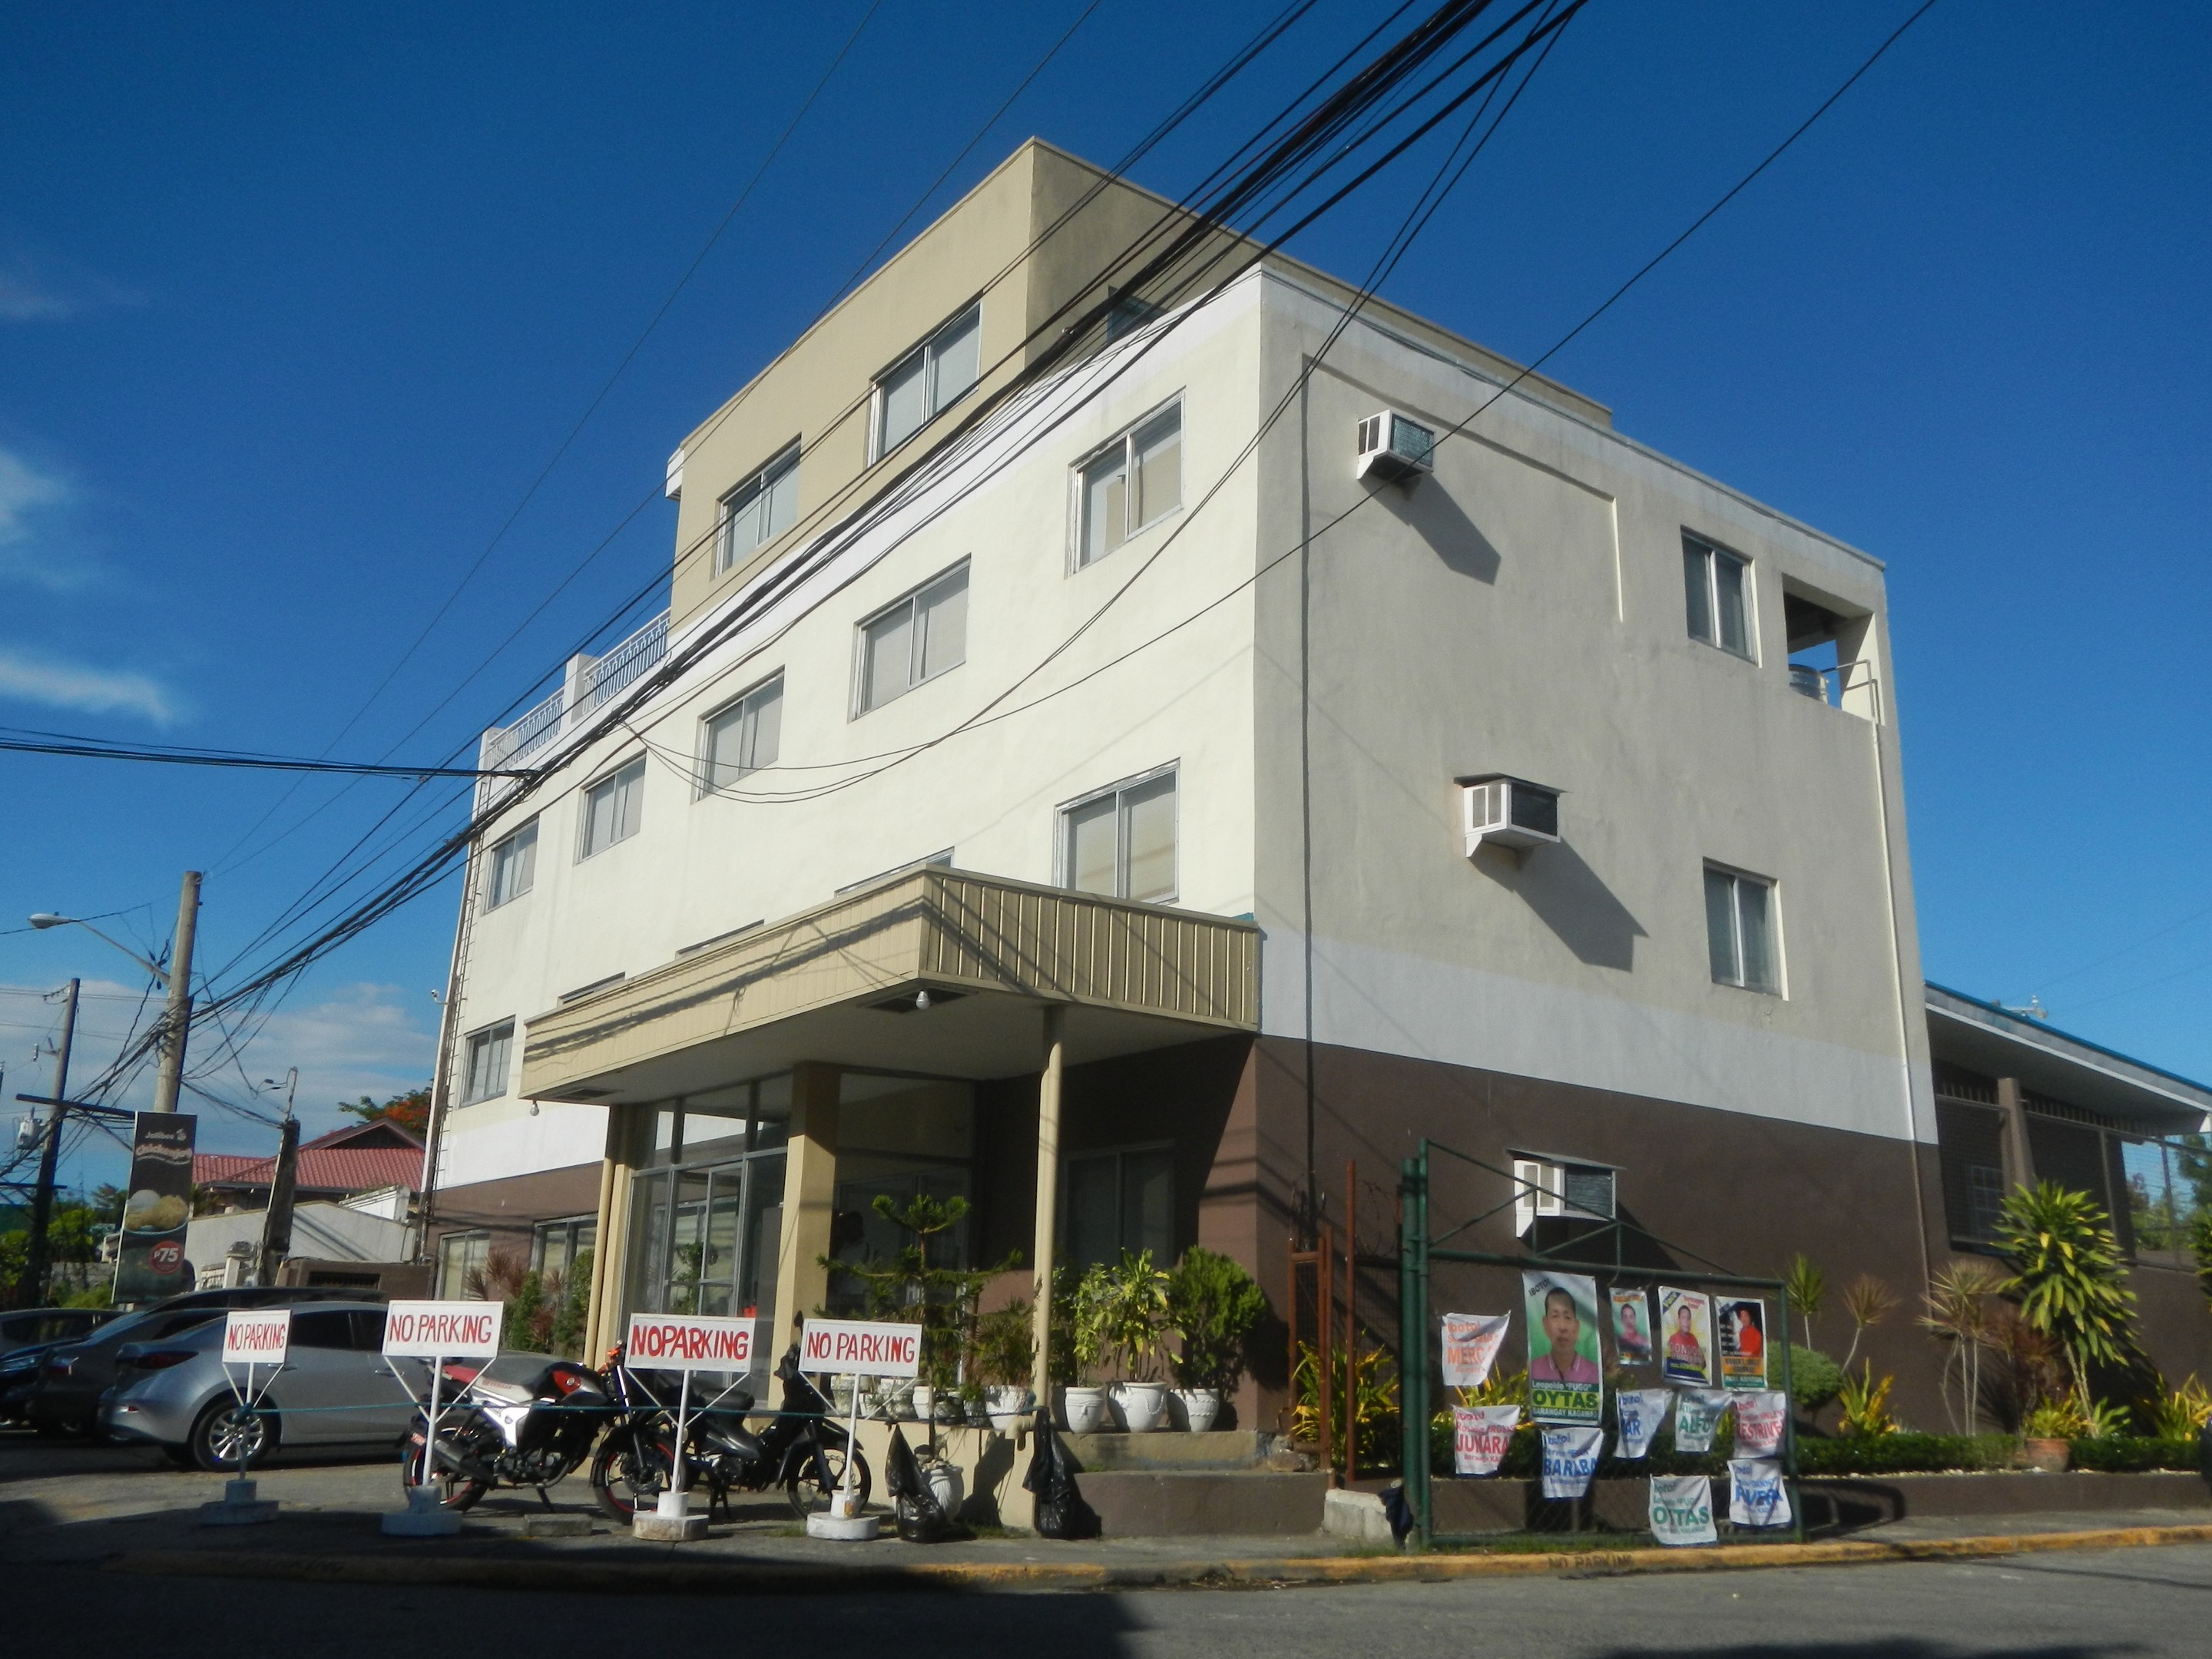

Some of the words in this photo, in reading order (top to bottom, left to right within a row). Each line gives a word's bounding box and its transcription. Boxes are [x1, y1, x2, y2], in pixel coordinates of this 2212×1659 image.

[228, 1323, 243, 1350] NO
[243, 1323, 286, 1350] PARKING
[389, 1314, 415, 1342] NO
[417, 1314, 492, 1343] PARKING
[806, 1331, 832, 1359] NO
[836, 1333, 915, 1363] PARKING
[1532, 1389, 1598, 1409] OYTAS
